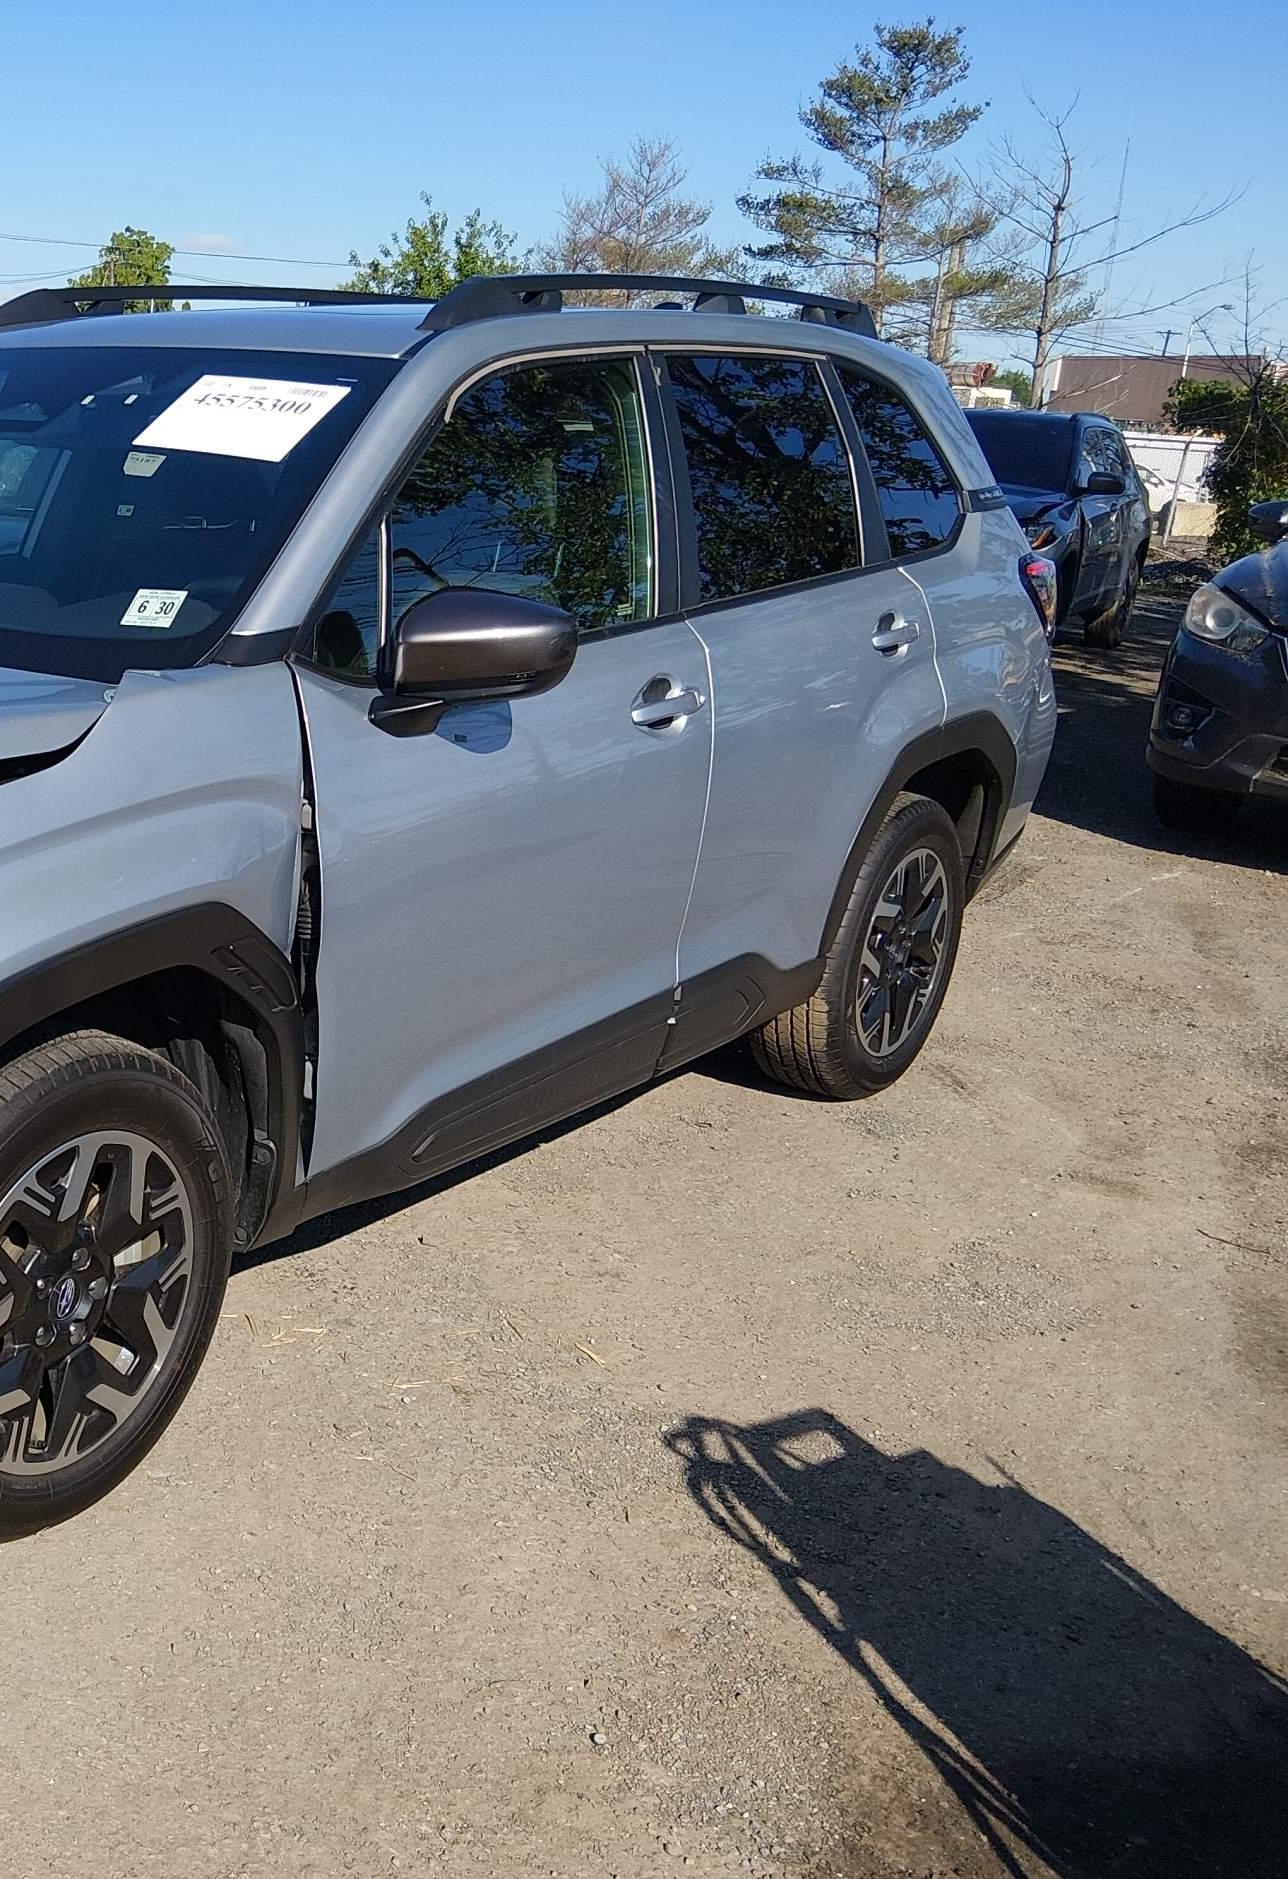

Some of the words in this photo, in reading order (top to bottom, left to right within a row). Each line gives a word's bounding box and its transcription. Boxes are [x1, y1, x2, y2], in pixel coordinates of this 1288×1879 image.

[193, 392, 312, 415] 45575300
[137, 600, 150, 614] 6
[154, 601, 175, 615] 30
